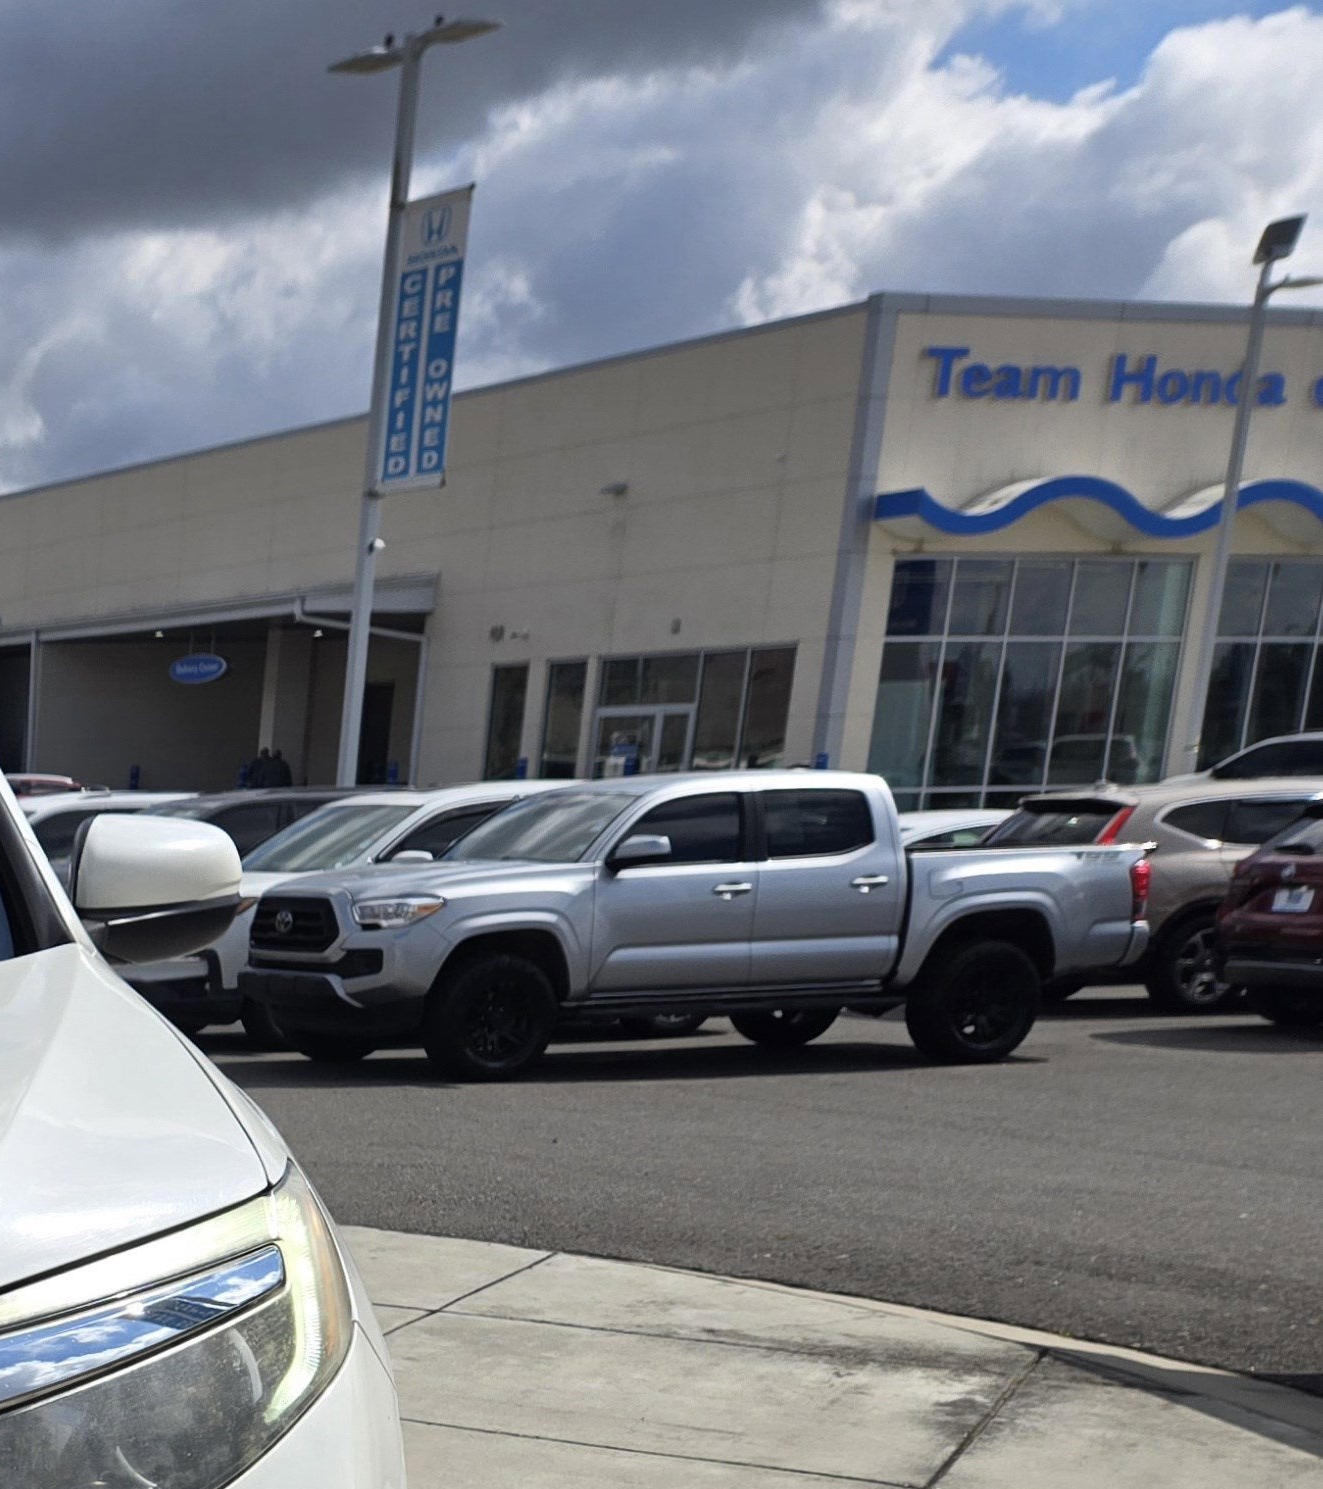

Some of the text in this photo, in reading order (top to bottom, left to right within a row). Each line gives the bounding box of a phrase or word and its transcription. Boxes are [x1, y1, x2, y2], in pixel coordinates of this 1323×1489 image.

[387, 273, 423, 476] CERTIFIED
[420, 265, 456, 471] PRE OWNED
[926, 346, 1082, 401] Team
